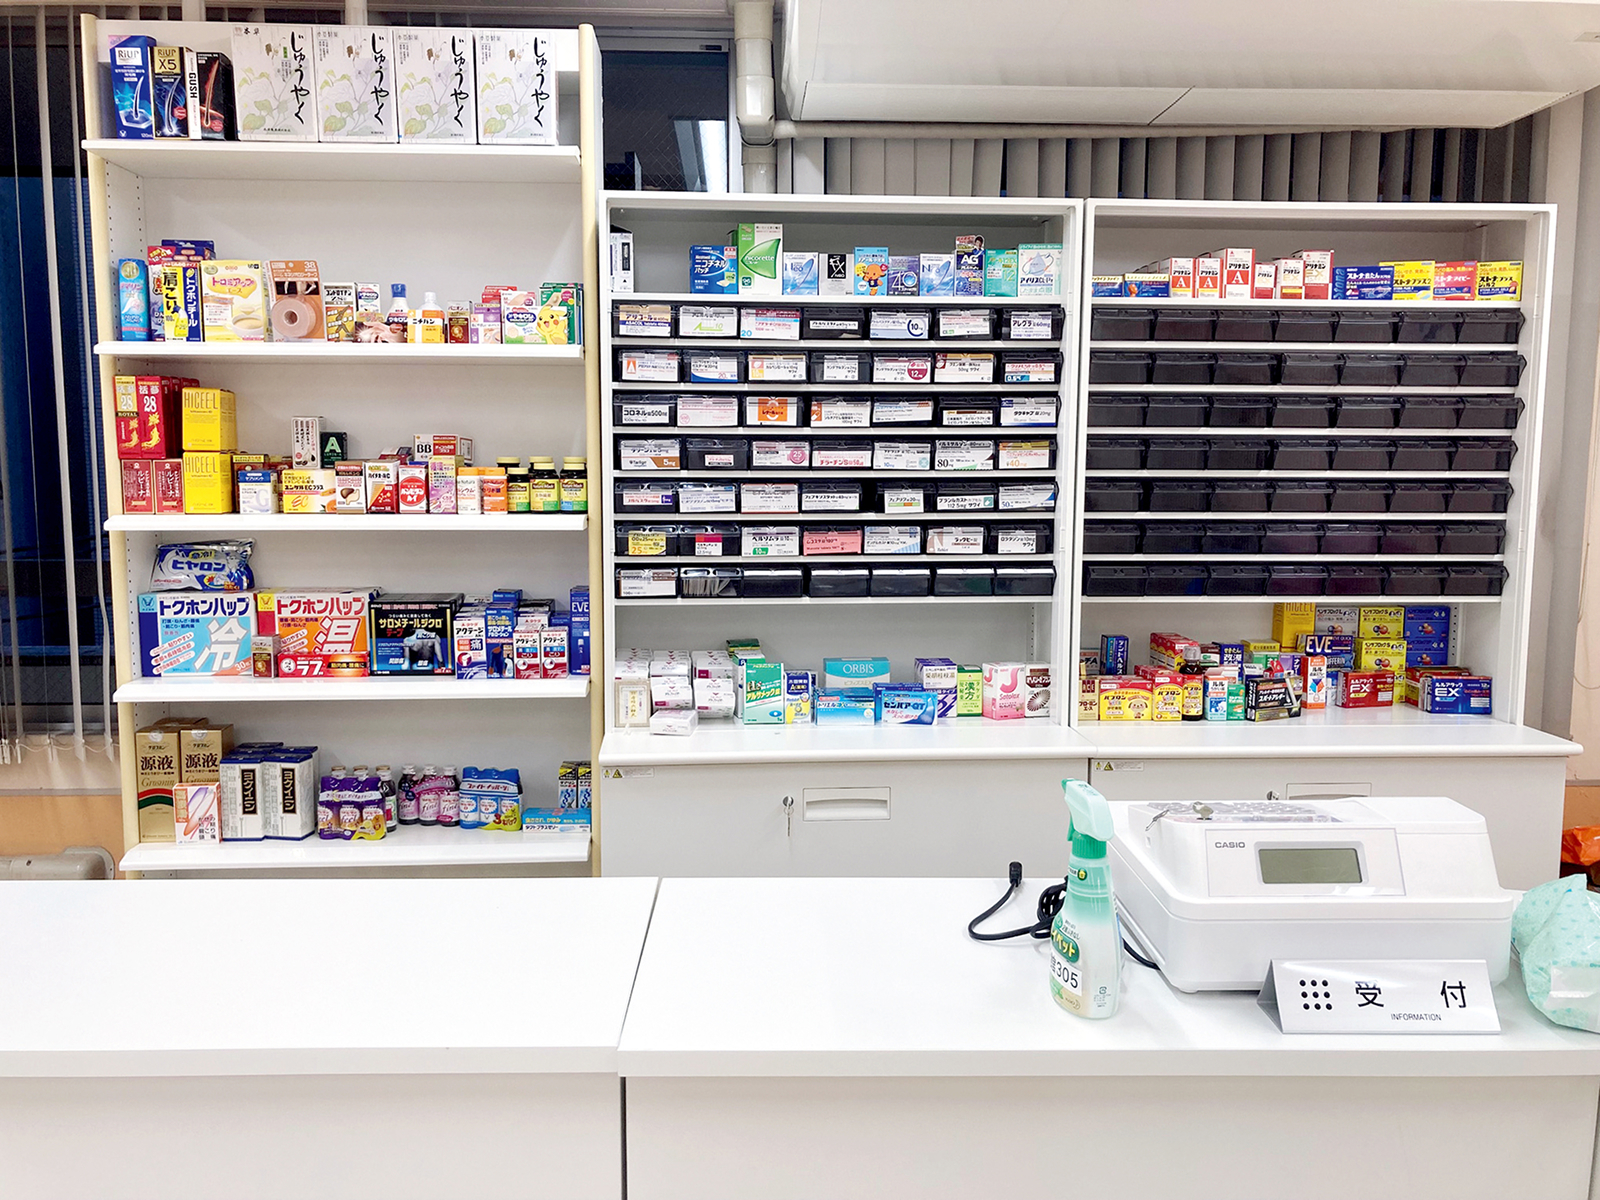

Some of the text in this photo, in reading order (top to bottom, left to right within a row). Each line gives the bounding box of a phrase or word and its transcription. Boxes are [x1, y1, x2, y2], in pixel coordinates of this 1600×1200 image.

[158, 58, 177, 70] X5
[189, 72, 198, 98] GUSH
[370, 32, 390, 126] じゅうやく
[450, 35, 468, 128] じゅうやく
[531, 36, 550, 128] じゅうやく
[961, 256, 978, 265] AG
[1176, 277, 1188, 288] A
[1204, 277, 1215, 288] A
[1232, 271, 1246, 284] A
[186, 277, 198, 326] トクホンチール
[121, 396, 134, 410] 28
[144, 395, 156, 412] 28
[416, 444, 432, 454] BB
[172, 560, 226, 572] ヒヤロン
[160, 598, 249, 616] トクホンハップ
[278, 597, 365, 616] トクホンハップ
[572, 602, 589, 612] EVE
[378, 618, 442, 628] サロメチールジクロ
[386, 628, 404, 637] テープ
[455, 628, 484, 636] アクテージ
[193, 617, 249, 671] 冷
[470, 639, 482, 650] 痛
[1306, 636, 1332, 653] EVE
[842, 664, 874, 674] ORBIS
[964, 681, 976, 700] 漢方
[1350, 684, 1370, 692] FX
[1434, 688, 1460, 697] EX
[140, 754, 174, 770] 源液
[186, 752, 218, 768] 源液
[243, 771, 255, 812] ヨクイニン
[282, 771, 295, 812] ヨクイニン
[1056, 961, 1078, 988] 305
[1390, 1013, 1442, 1021] INFORMATION
